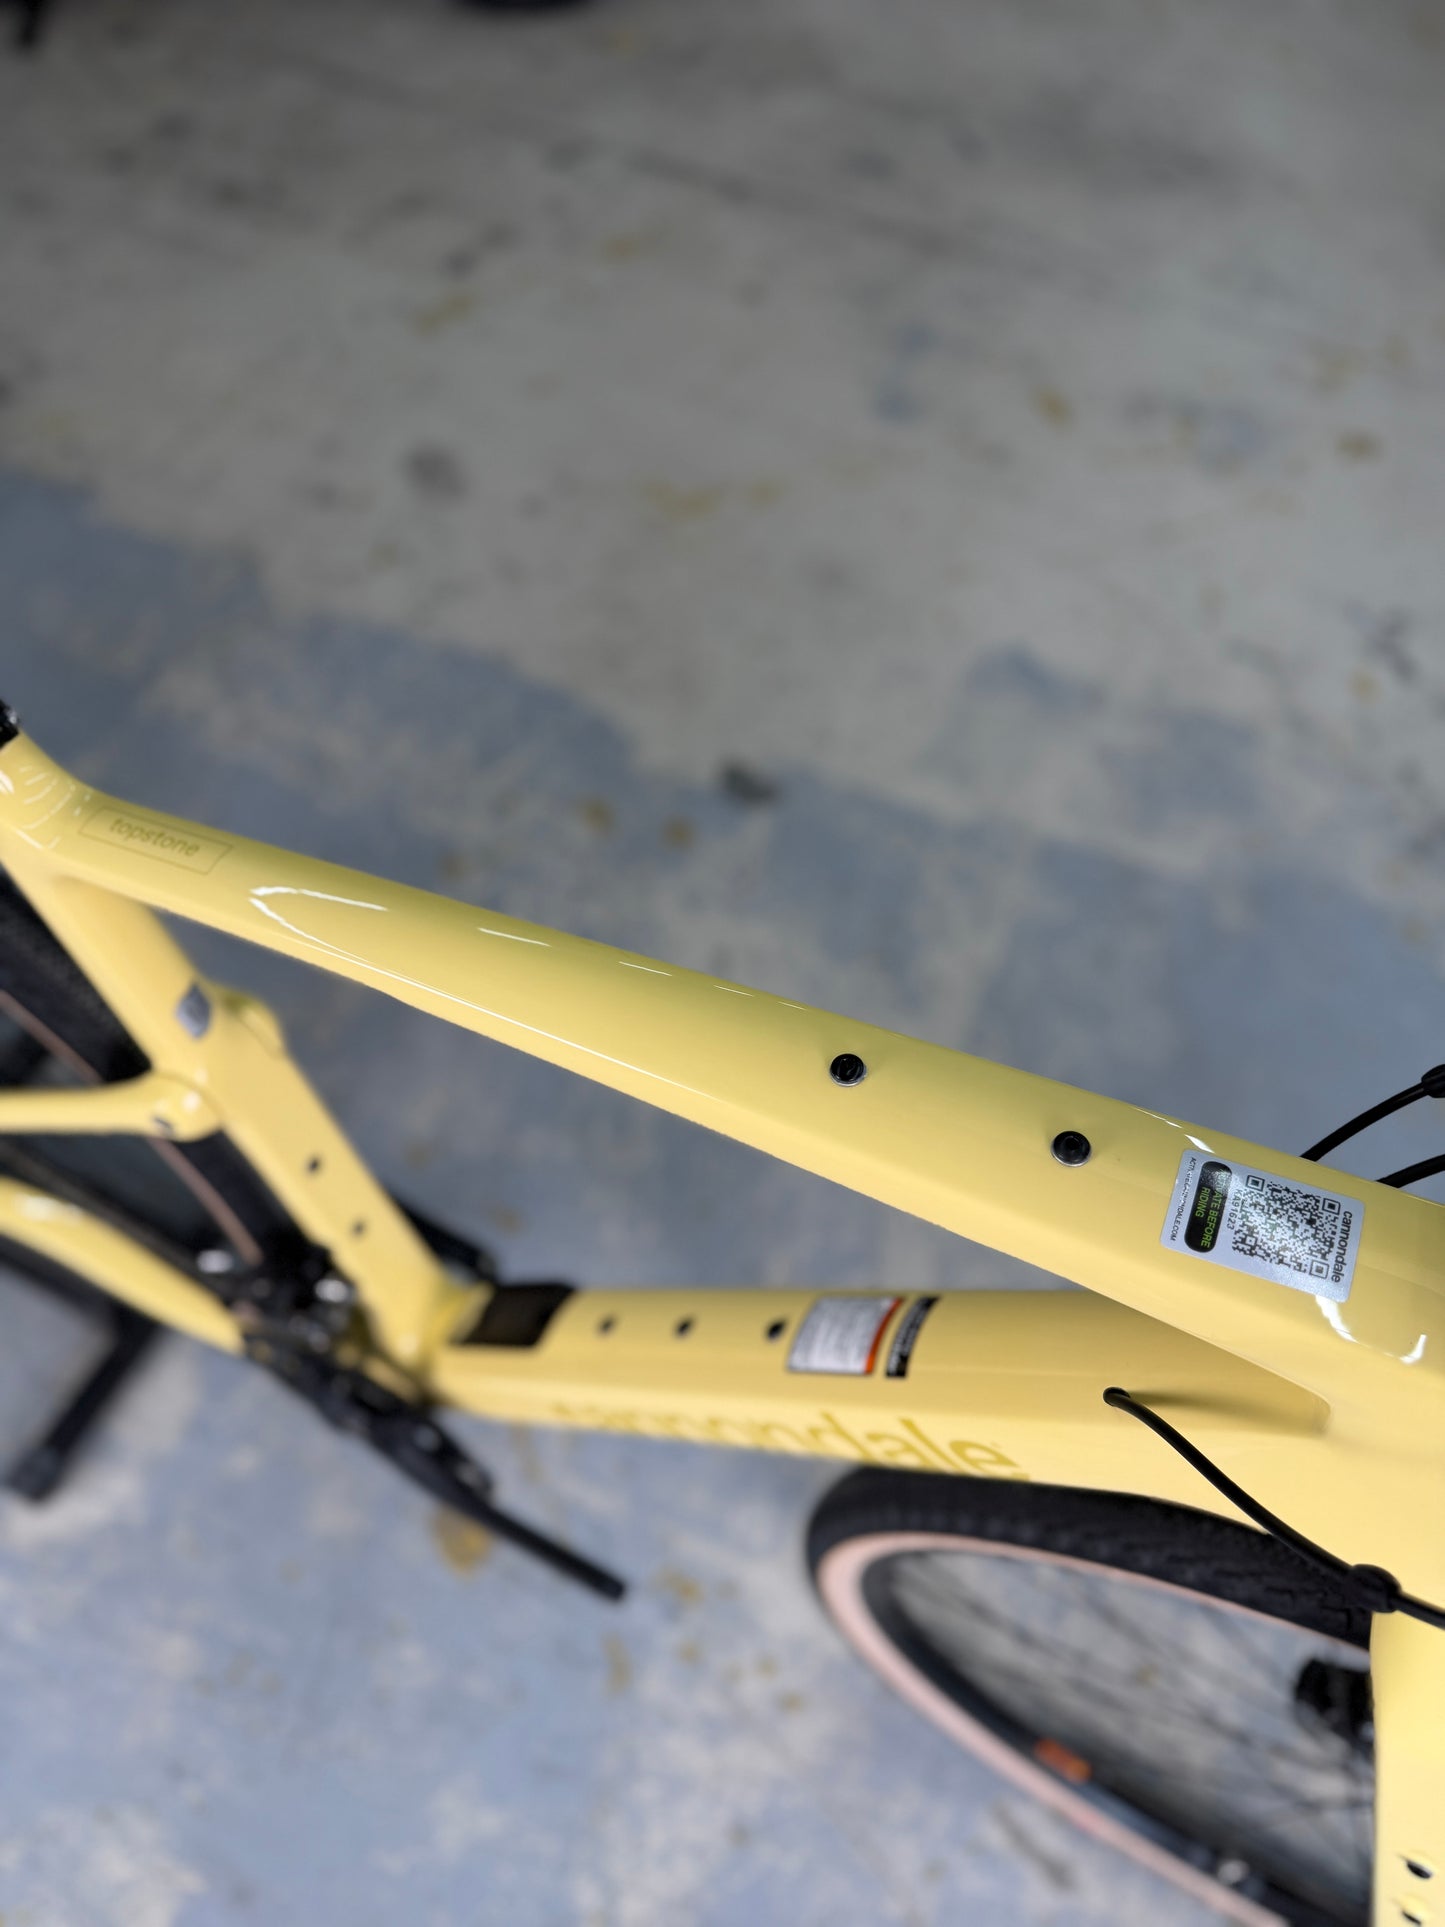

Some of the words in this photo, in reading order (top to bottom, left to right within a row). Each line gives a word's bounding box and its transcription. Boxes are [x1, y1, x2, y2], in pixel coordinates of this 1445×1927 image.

[109, 818, 200, 857] topstone
[1195, 1187, 1211, 1218] RIDING
[1211, 1168, 1229, 1209] ACTIVATE
[1227, 1188, 1243, 1230] KA91623
[1201, 1209, 1218, 1248] BEFORE
[1331, 1210, 1352, 1282] cannondale
[551, 1404, 1030, 1480] ondale
